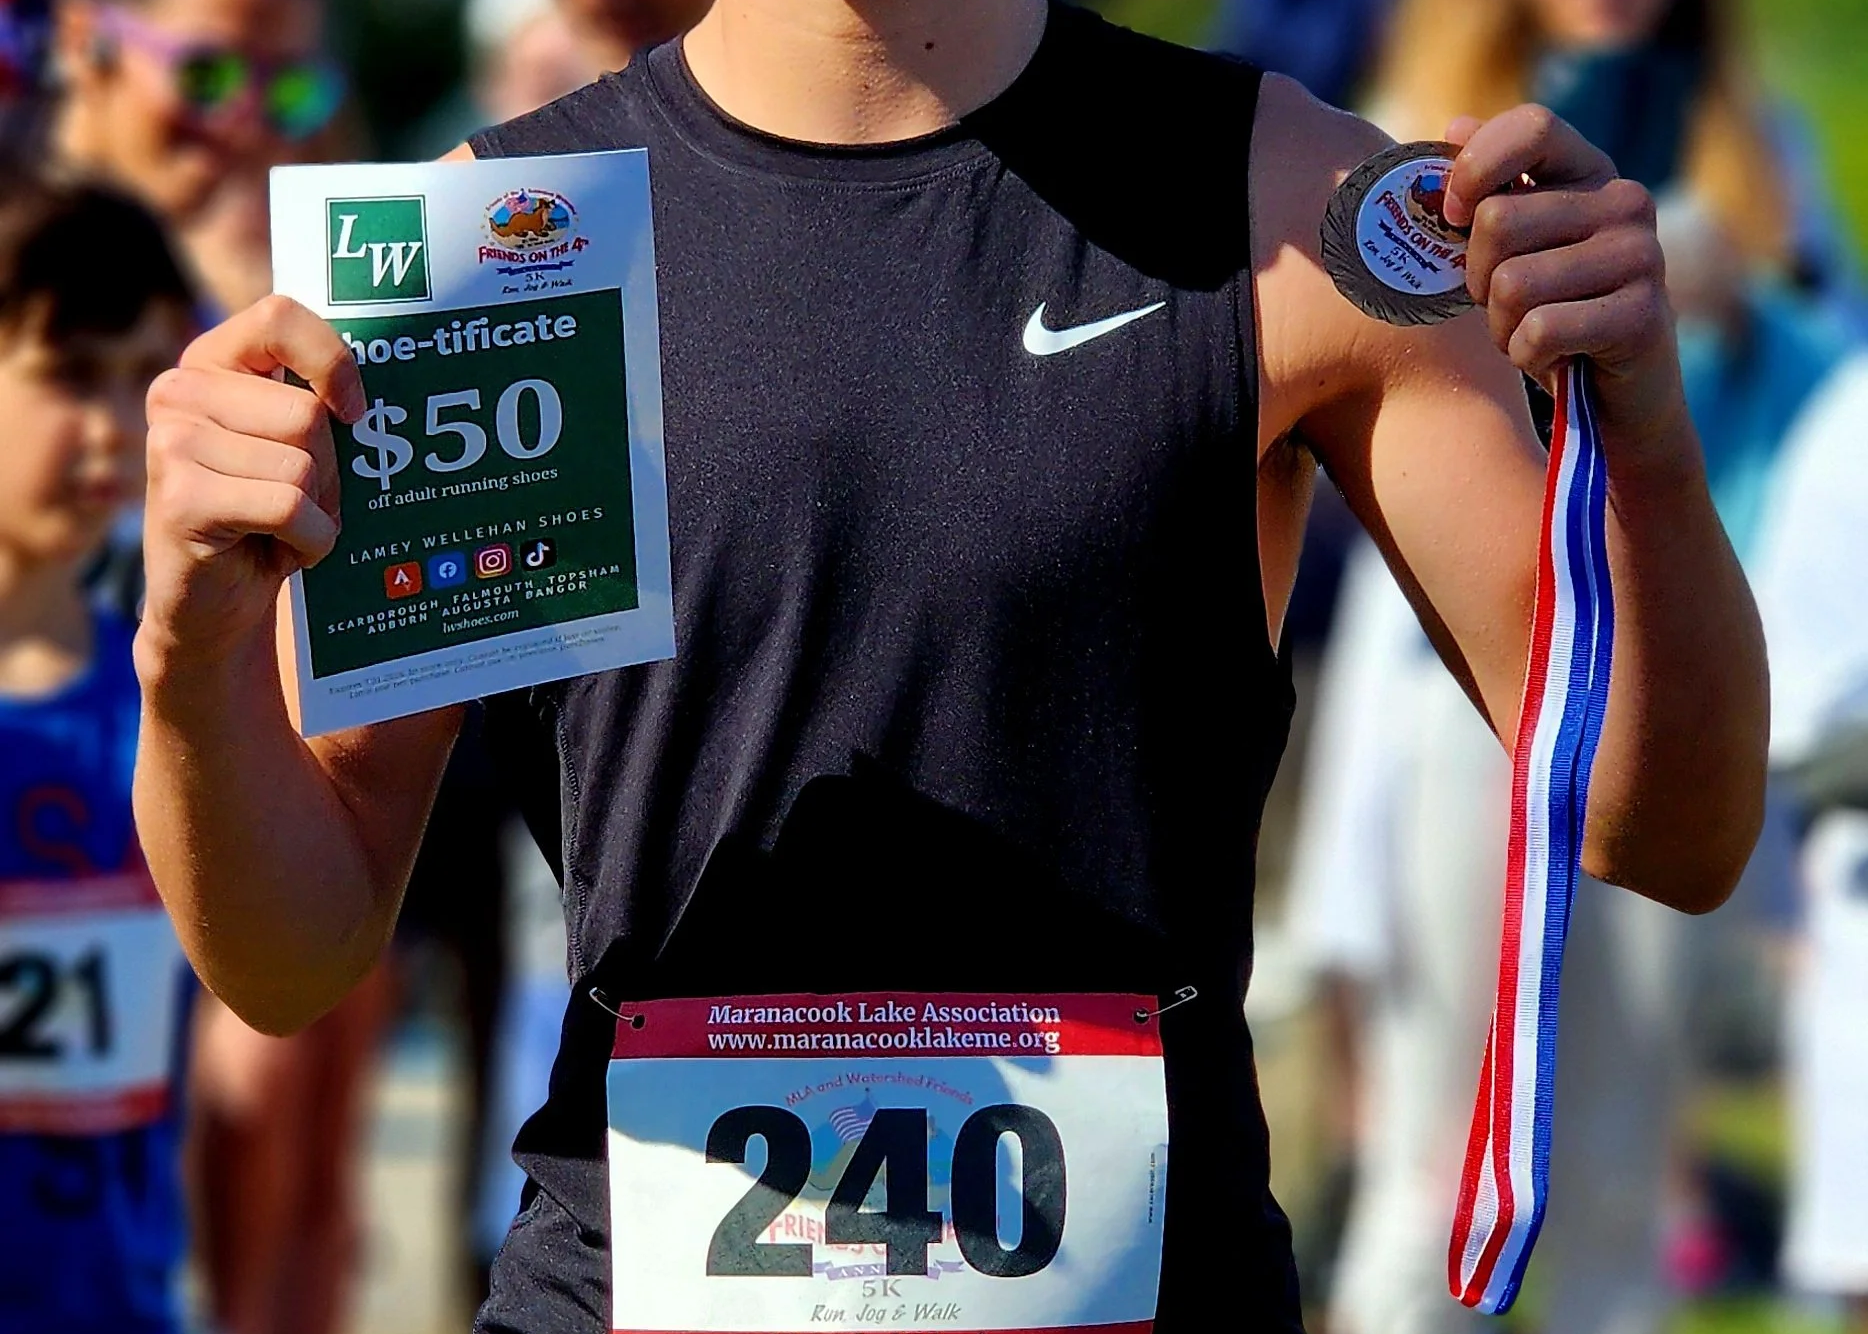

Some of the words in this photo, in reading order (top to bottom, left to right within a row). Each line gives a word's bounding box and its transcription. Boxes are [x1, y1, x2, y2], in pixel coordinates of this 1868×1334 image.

[1375, 190, 1414, 235] FRIENDS
[1411, 232, 1433, 251] ON
[1430, 242, 1454, 260] THE
[479, 246, 526, 264] FRIENDS
[529, 251, 547, 263] ON
[550, 242, 569, 258] THE
[342, 315, 577, 365] hoe-tificate
[351, 378, 563, 491] $50
[368, 494, 392, 511] off
[395, 486, 437, 505] adult
[441, 475, 509, 497] running
[512, 467, 559, 486] shoes
[350, 540, 412, 565] LAMEY
[422, 520, 527, 549] WELLEHAN
[538, 507, 604, 528] SHOES
[327, 599, 439, 634] SCARBOROUGH
[453, 580, 534, 604] FALMOUTH
[547, 565, 620, 585] TOPSHAM
[367, 613, 428, 635] AUBURN
[442, 595, 511, 617] AUGUSTA
[525, 580, 588, 600] BANGOR
[443, 607, 519, 634] lwshoes.com
[707, 1002, 853, 1026] Maranacook
[858, 1002, 917, 1023] Lake
[922, 1001, 1061, 1023] Association
[707, 1026, 1061, 1054] www.maranacooklakeme.org
[785, 1085, 815, 1107] MLA
[817, 1076, 843, 1093] and
[846, 1071, 924, 1087] Watershed
[925, 1077, 975, 1106] Friends
[705, 1103, 1069, 1279] 240
[862, 1278, 902, 1298] 5K
[856, 1303, 887, 1324] Jog
[891, 1304, 907, 1321] &
[914, 1302, 962, 1323] Walk
